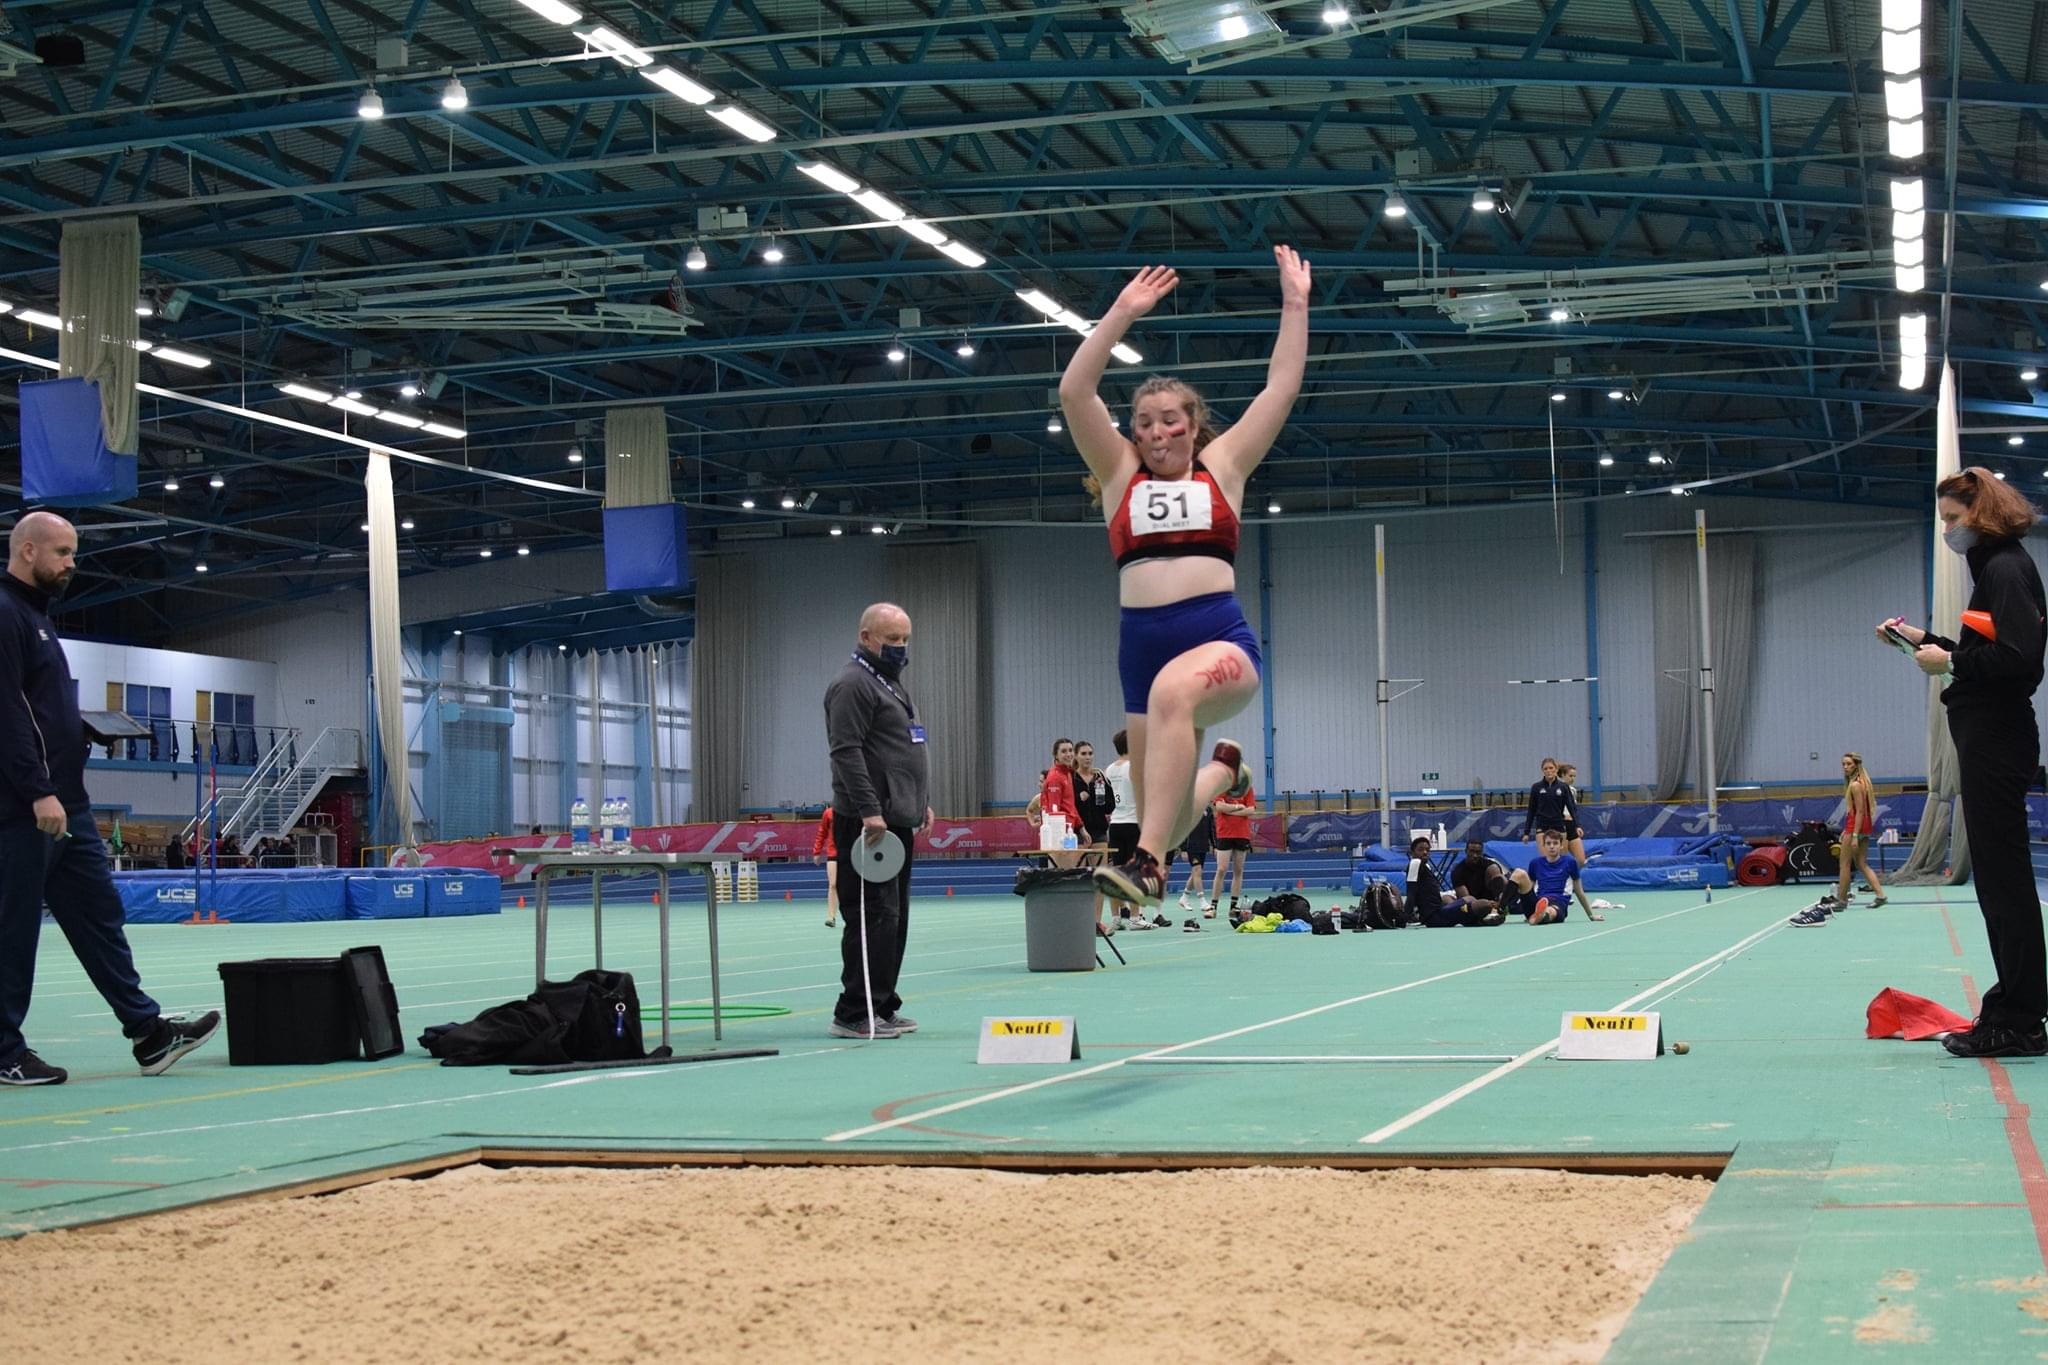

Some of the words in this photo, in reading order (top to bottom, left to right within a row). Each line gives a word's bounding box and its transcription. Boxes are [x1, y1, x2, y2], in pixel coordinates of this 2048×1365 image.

[1147, 492, 1188, 521] 51
[393, 883, 414, 894] UCS
[445, 881, 464, 892] UCS
[156, 888, 197, 899] UCS
[1003, 1022, 1052, 1034] Neuff
[1583, 1017, 1634, 1029] Neuff
